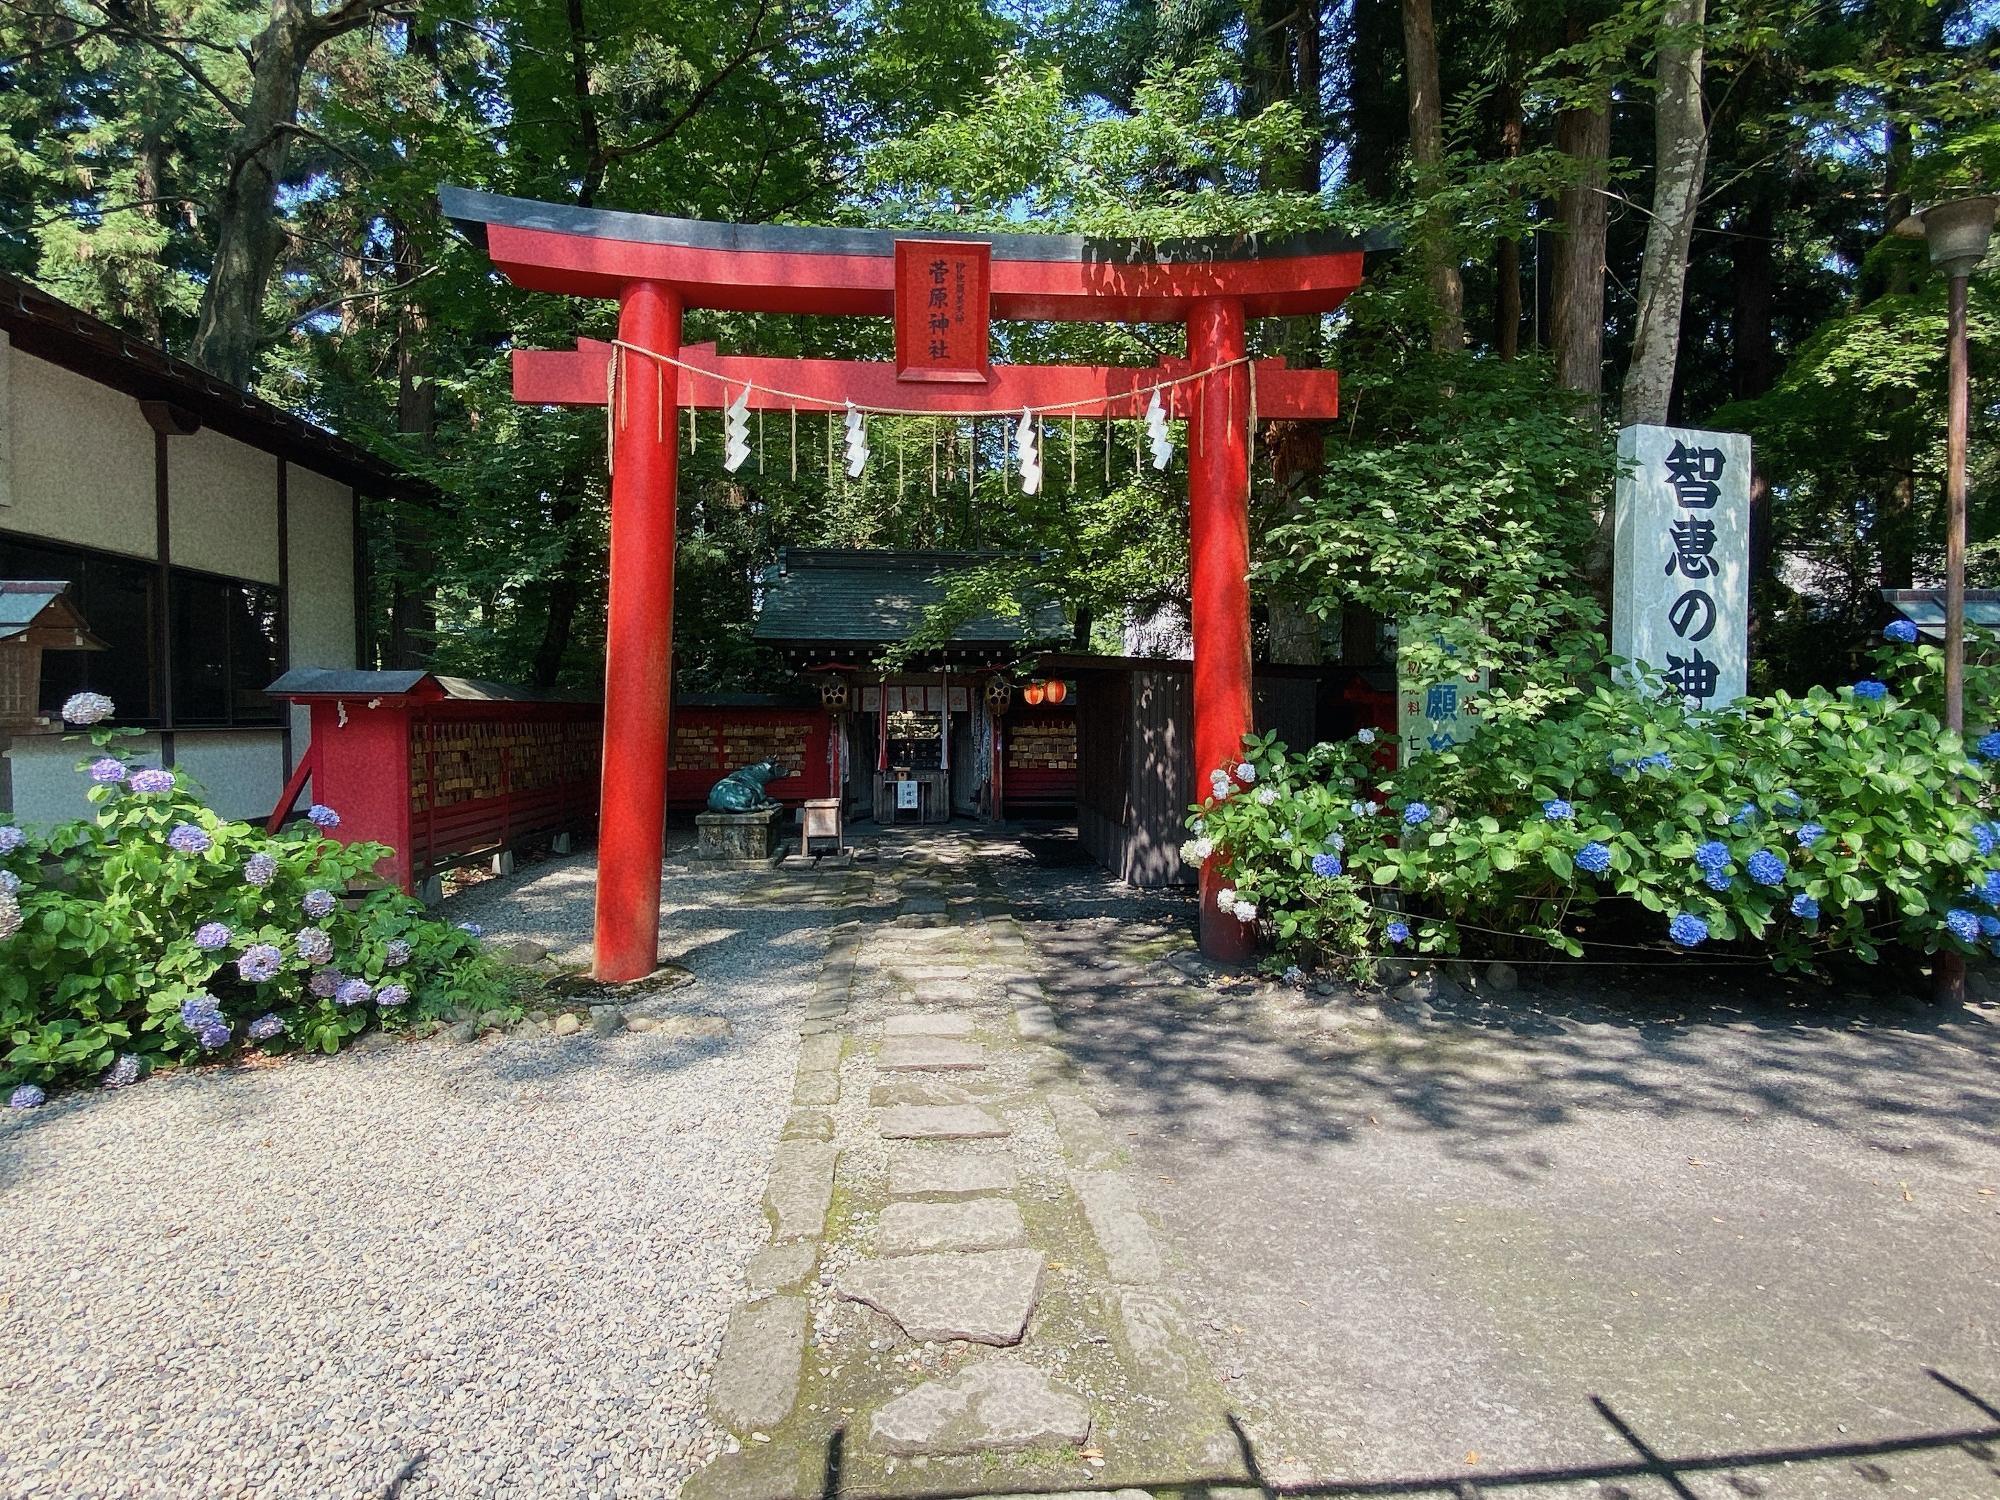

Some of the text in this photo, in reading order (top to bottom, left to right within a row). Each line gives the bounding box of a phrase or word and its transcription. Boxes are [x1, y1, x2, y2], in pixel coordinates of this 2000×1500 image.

[928, 259, 950, 361] 菅原神社
[1661, 439, 1726, 711] 智恵の神
